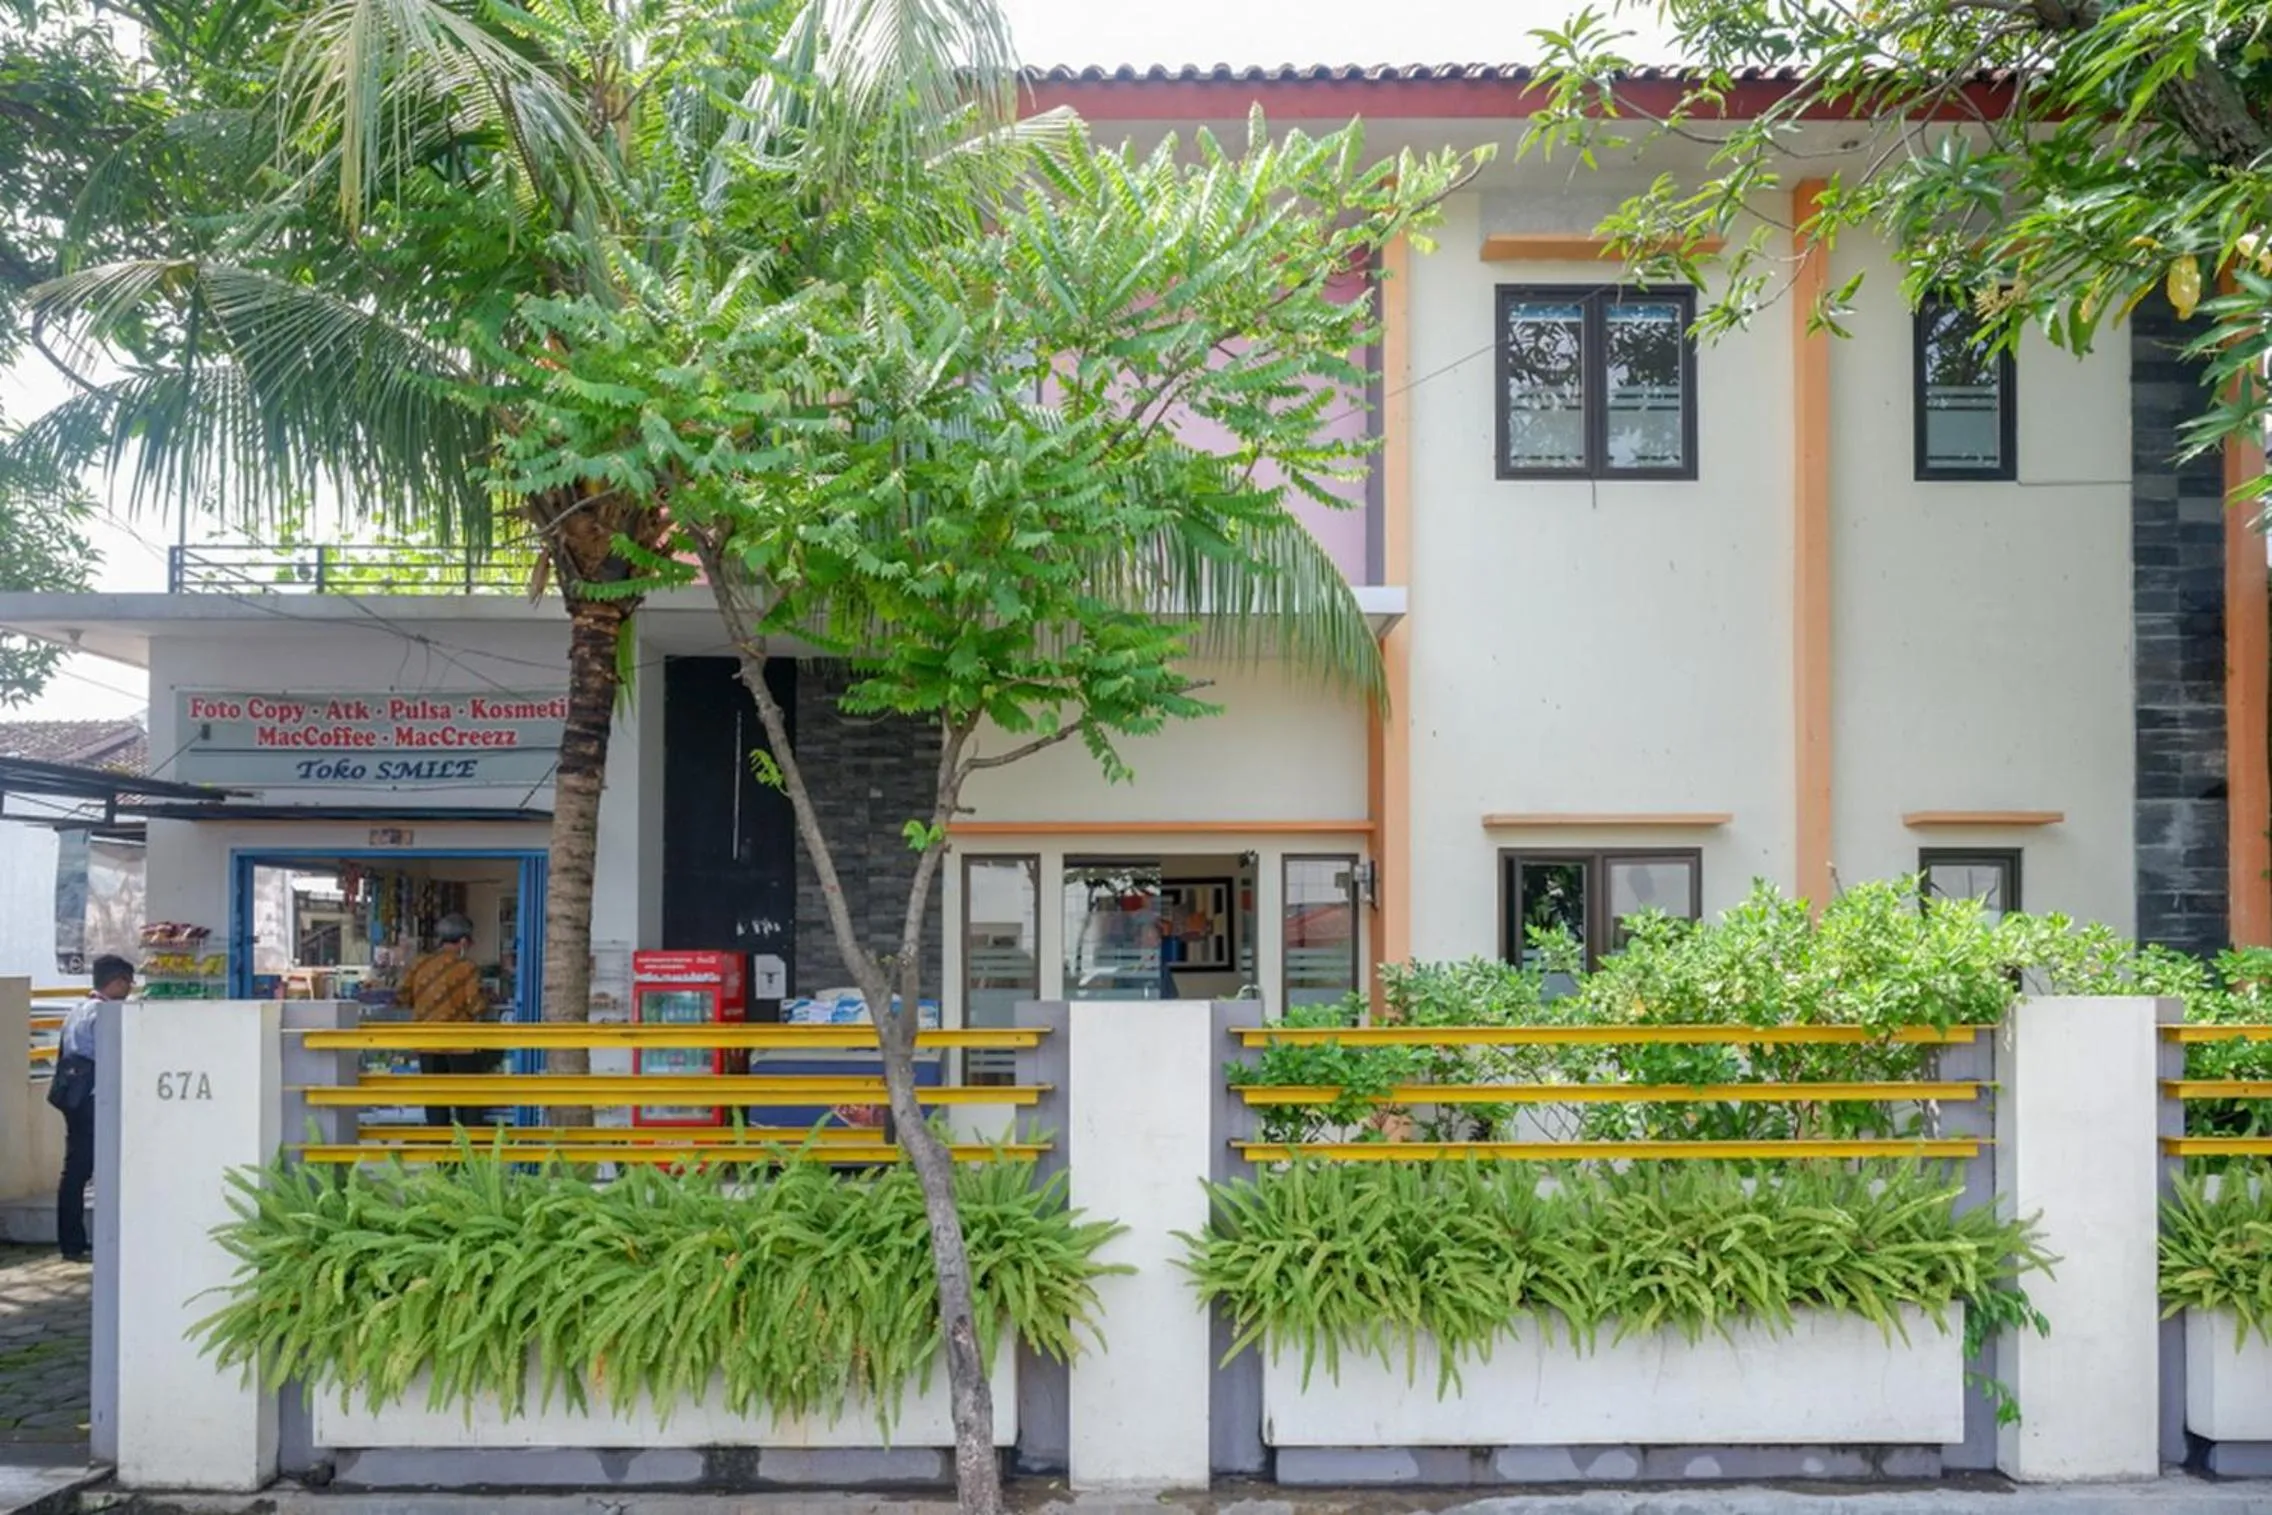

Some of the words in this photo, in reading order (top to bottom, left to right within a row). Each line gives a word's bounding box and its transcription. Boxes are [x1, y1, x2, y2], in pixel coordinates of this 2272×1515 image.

[190, 698, 241, 719] Foto
[248, 699, 305, 722] Copy
[326, 700, 370, 720] Atk
[390, 699, 451, 719] Pulsa
[470, 699, 571, 719] Kosmeti
[258, 726, 376, 746] MacCoffee
[395, 726, 517, 746] MacCreezz
[297, 758, 366, 779] Toko
[375, 759, 478, 780] SMILE
[157, 1071, 213, 1101] 67A
